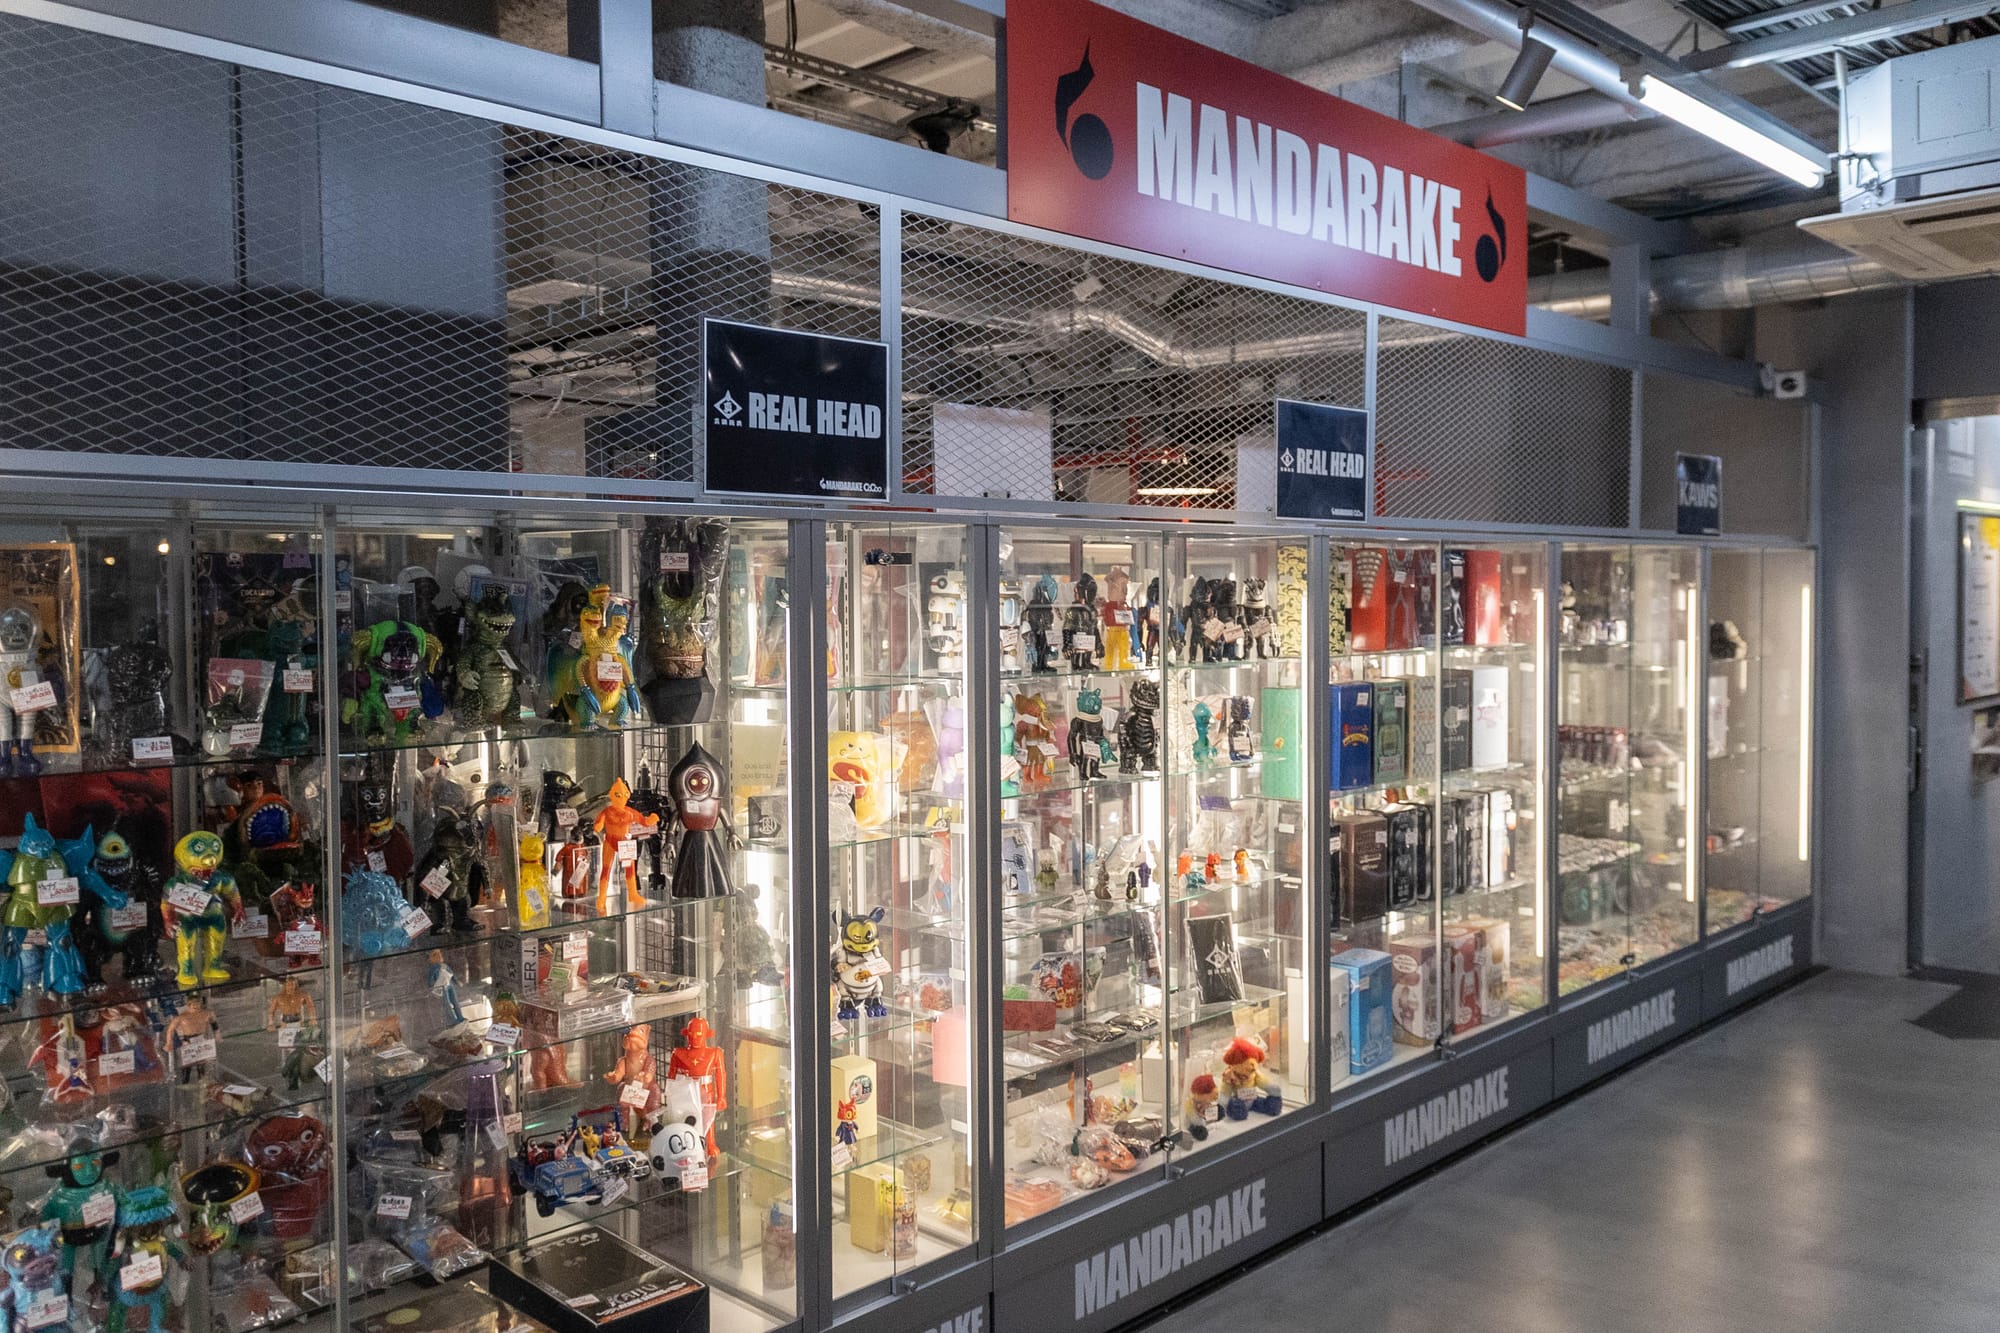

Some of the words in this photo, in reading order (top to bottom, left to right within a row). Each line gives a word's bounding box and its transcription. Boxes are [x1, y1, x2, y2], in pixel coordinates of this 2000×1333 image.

[1136, 81, 1462, 277] MANDARAKE
[748, 391, 811, 434] REAL
[817, 399, 882, 439] HEAD
[826, 480, 863, 492] MANDARAKE
[1296, 448, 1329, 476] REAL
[1330, 451, 1364, 479] HEAD
[1679, 481, 1718, 508] KAWS
[1727, 935, 1793, 997] MANDARAKE
[1587, 989, 1677, 1065] MANDARAKE
[1385, 1066, 1509, 1167] MANDARAKE
[1074, 1177, 1267, 1321] MANDARAKE
